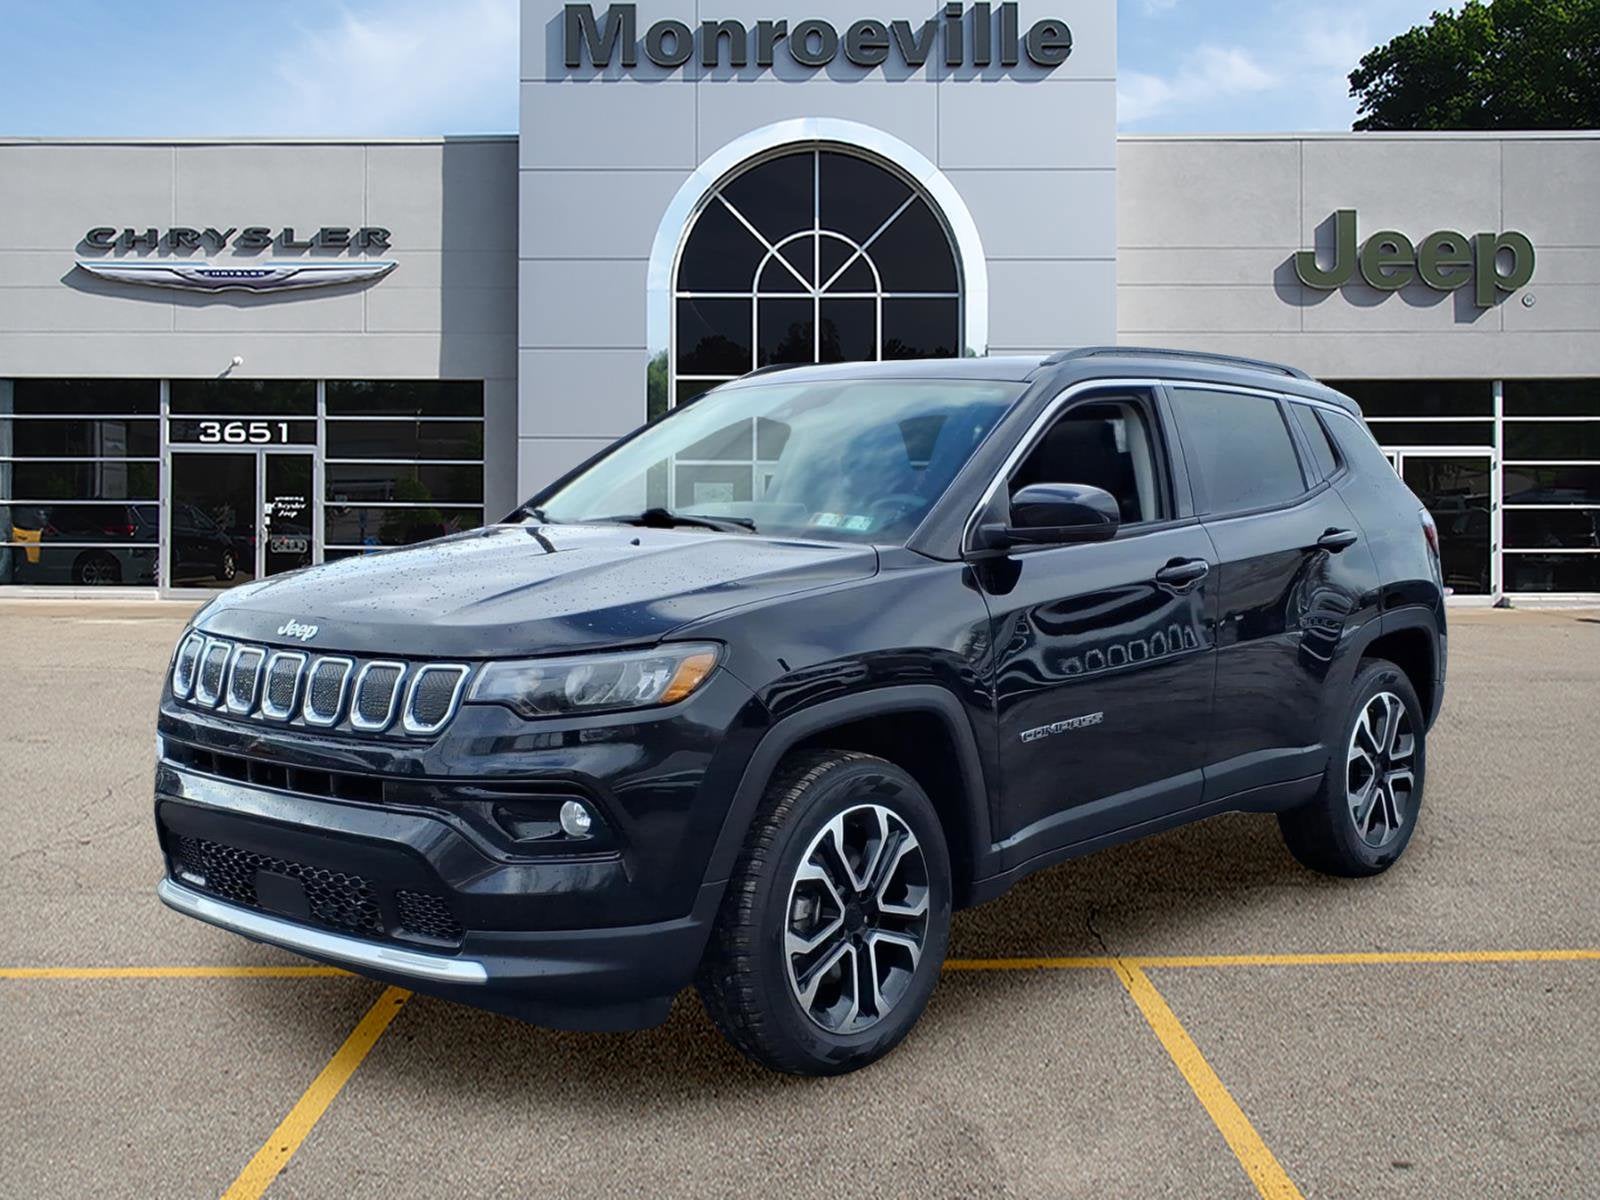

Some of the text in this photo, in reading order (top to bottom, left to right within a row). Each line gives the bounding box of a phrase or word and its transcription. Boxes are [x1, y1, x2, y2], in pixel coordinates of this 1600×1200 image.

[563, 2, 1073, 68] Monroeville
[85, 227, 392, 249] CHRYSLER
[1295, 209, 1536, 307] Jeep
[199, 421, 289, 443] 3651
[277, 618, 319, 642] Jeep
[1020, 711, 1104, 744] COMPASS
